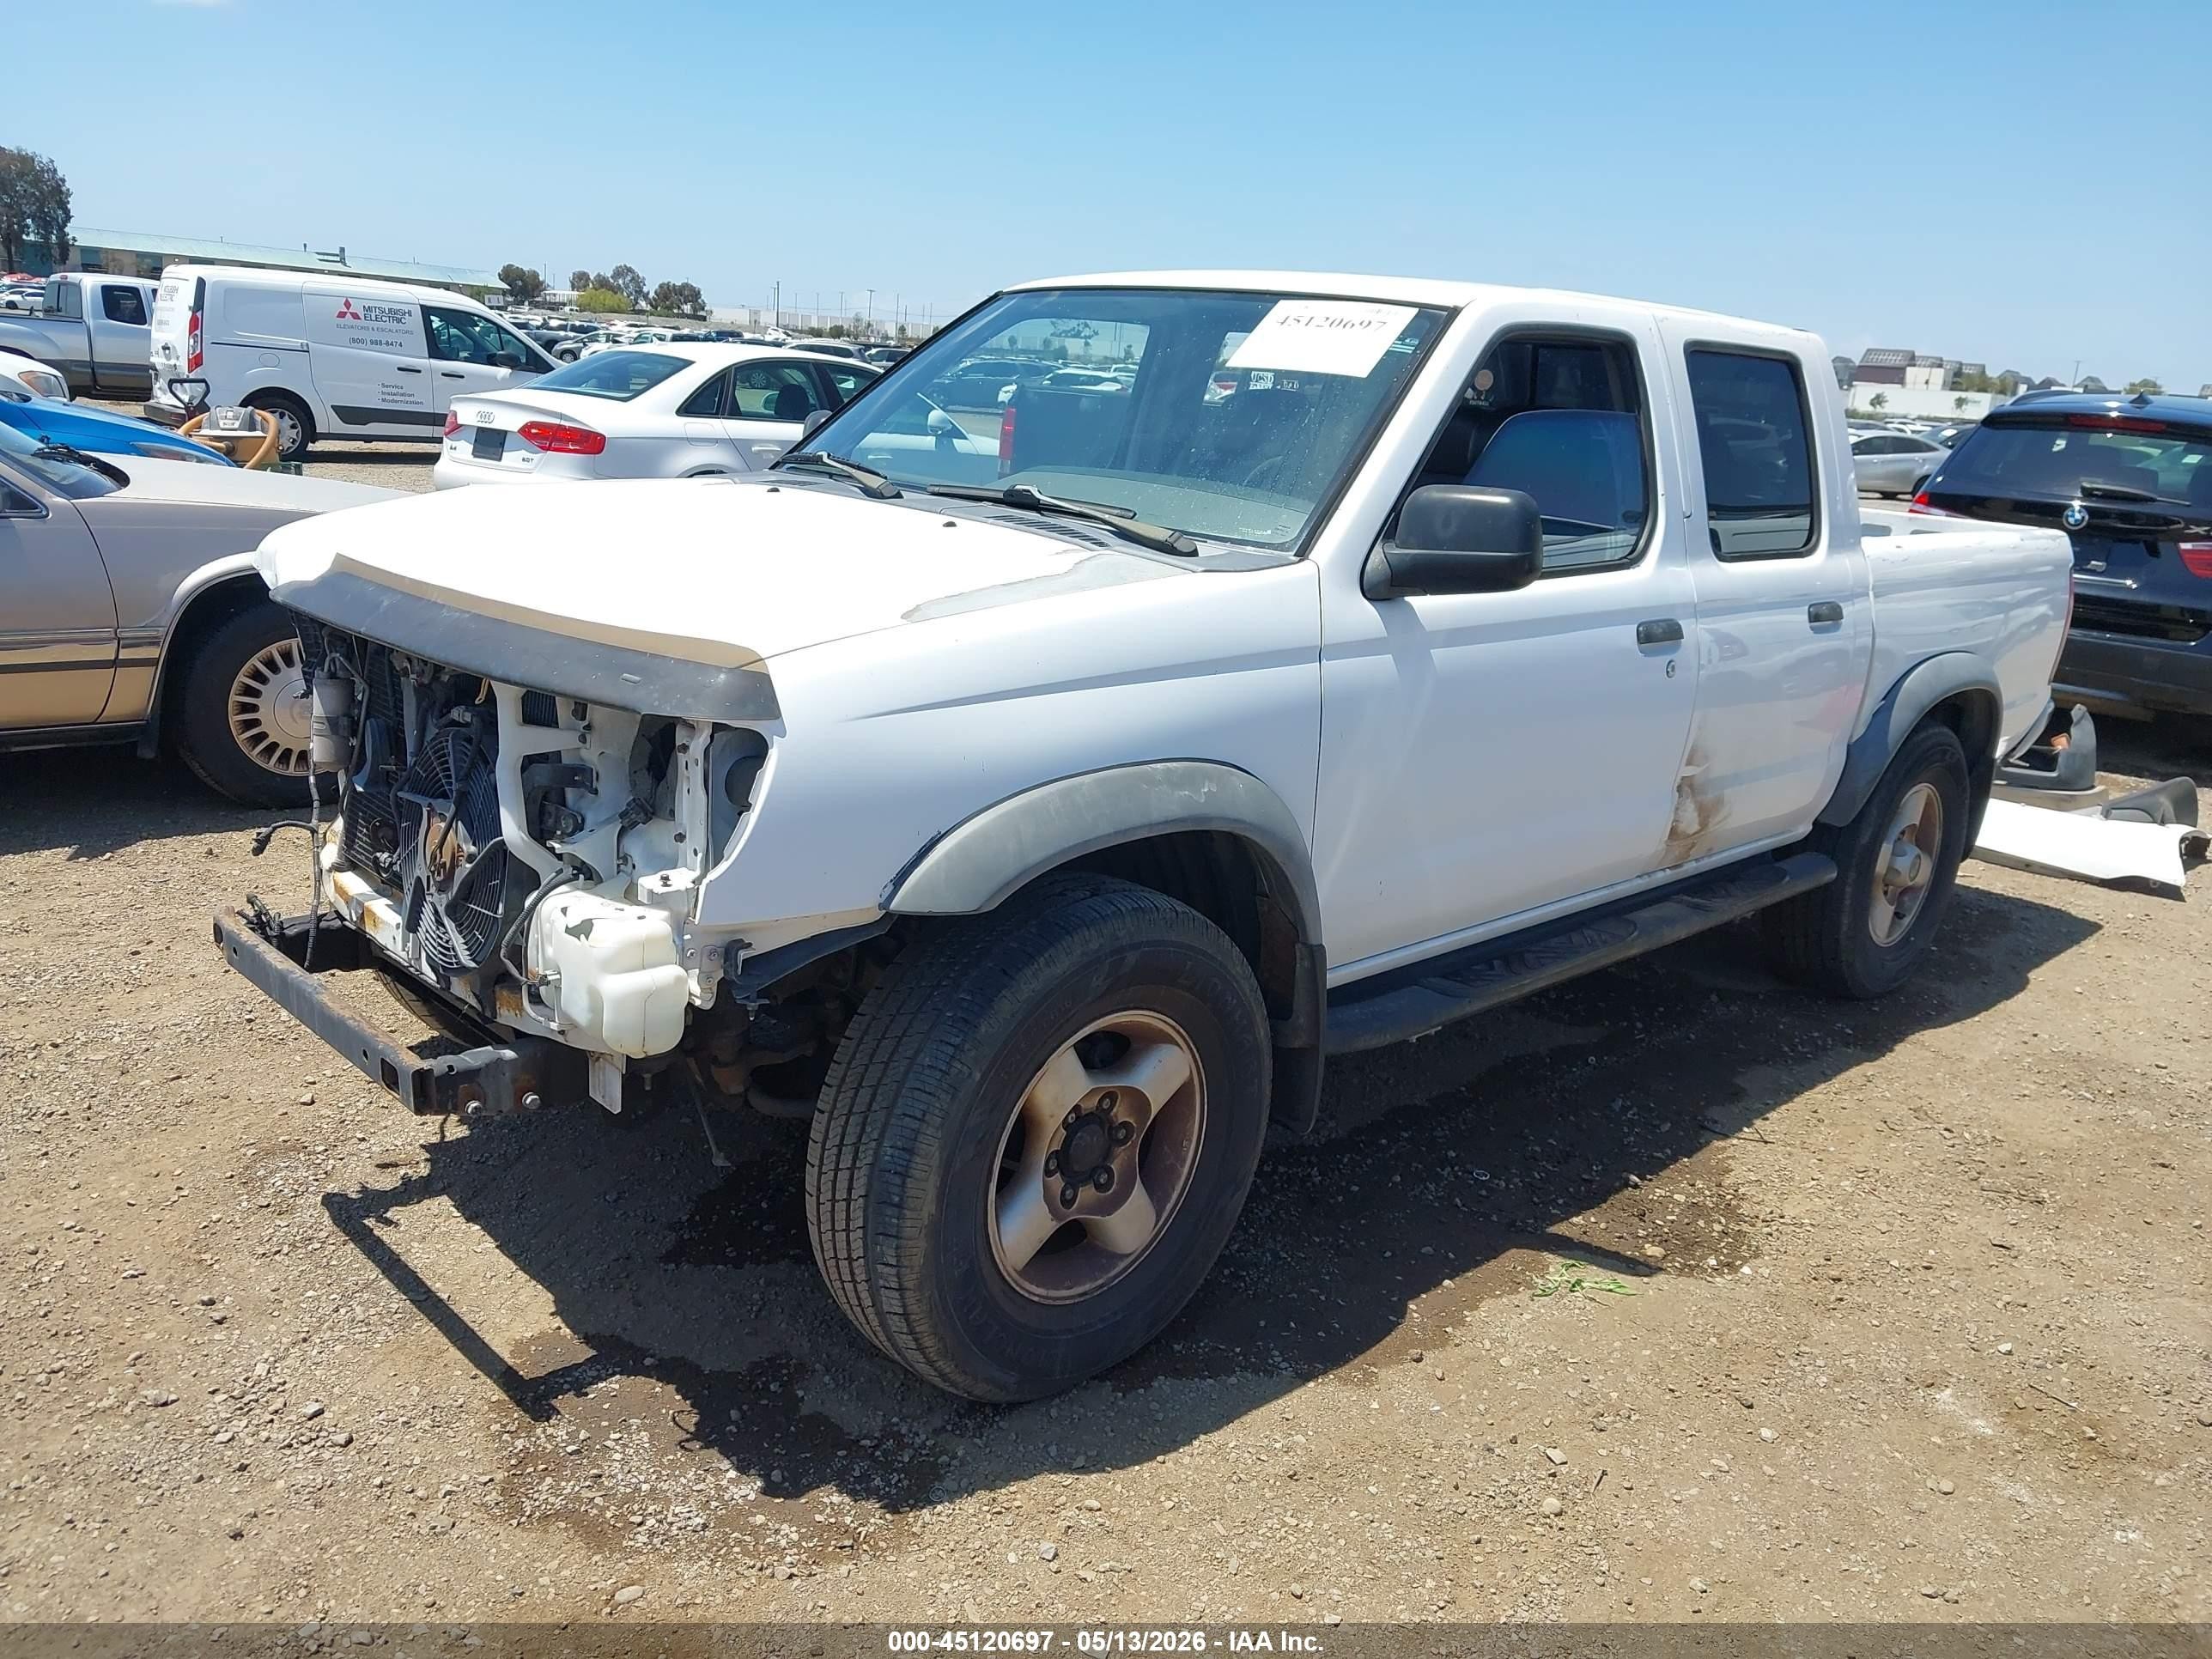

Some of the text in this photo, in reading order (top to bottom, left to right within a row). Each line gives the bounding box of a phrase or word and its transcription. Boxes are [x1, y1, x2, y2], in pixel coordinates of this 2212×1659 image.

[362, 305, 412, 318] MITSUBISHI
[363, 313, 407, 325] ELECTRIC
[336, 323, 370, 331] ELEVATORS
[376, 327, 415, 336] ESCALATORS
[380, 390, 416, 398] Installation
[380, 397, 424, 406] Modernization
